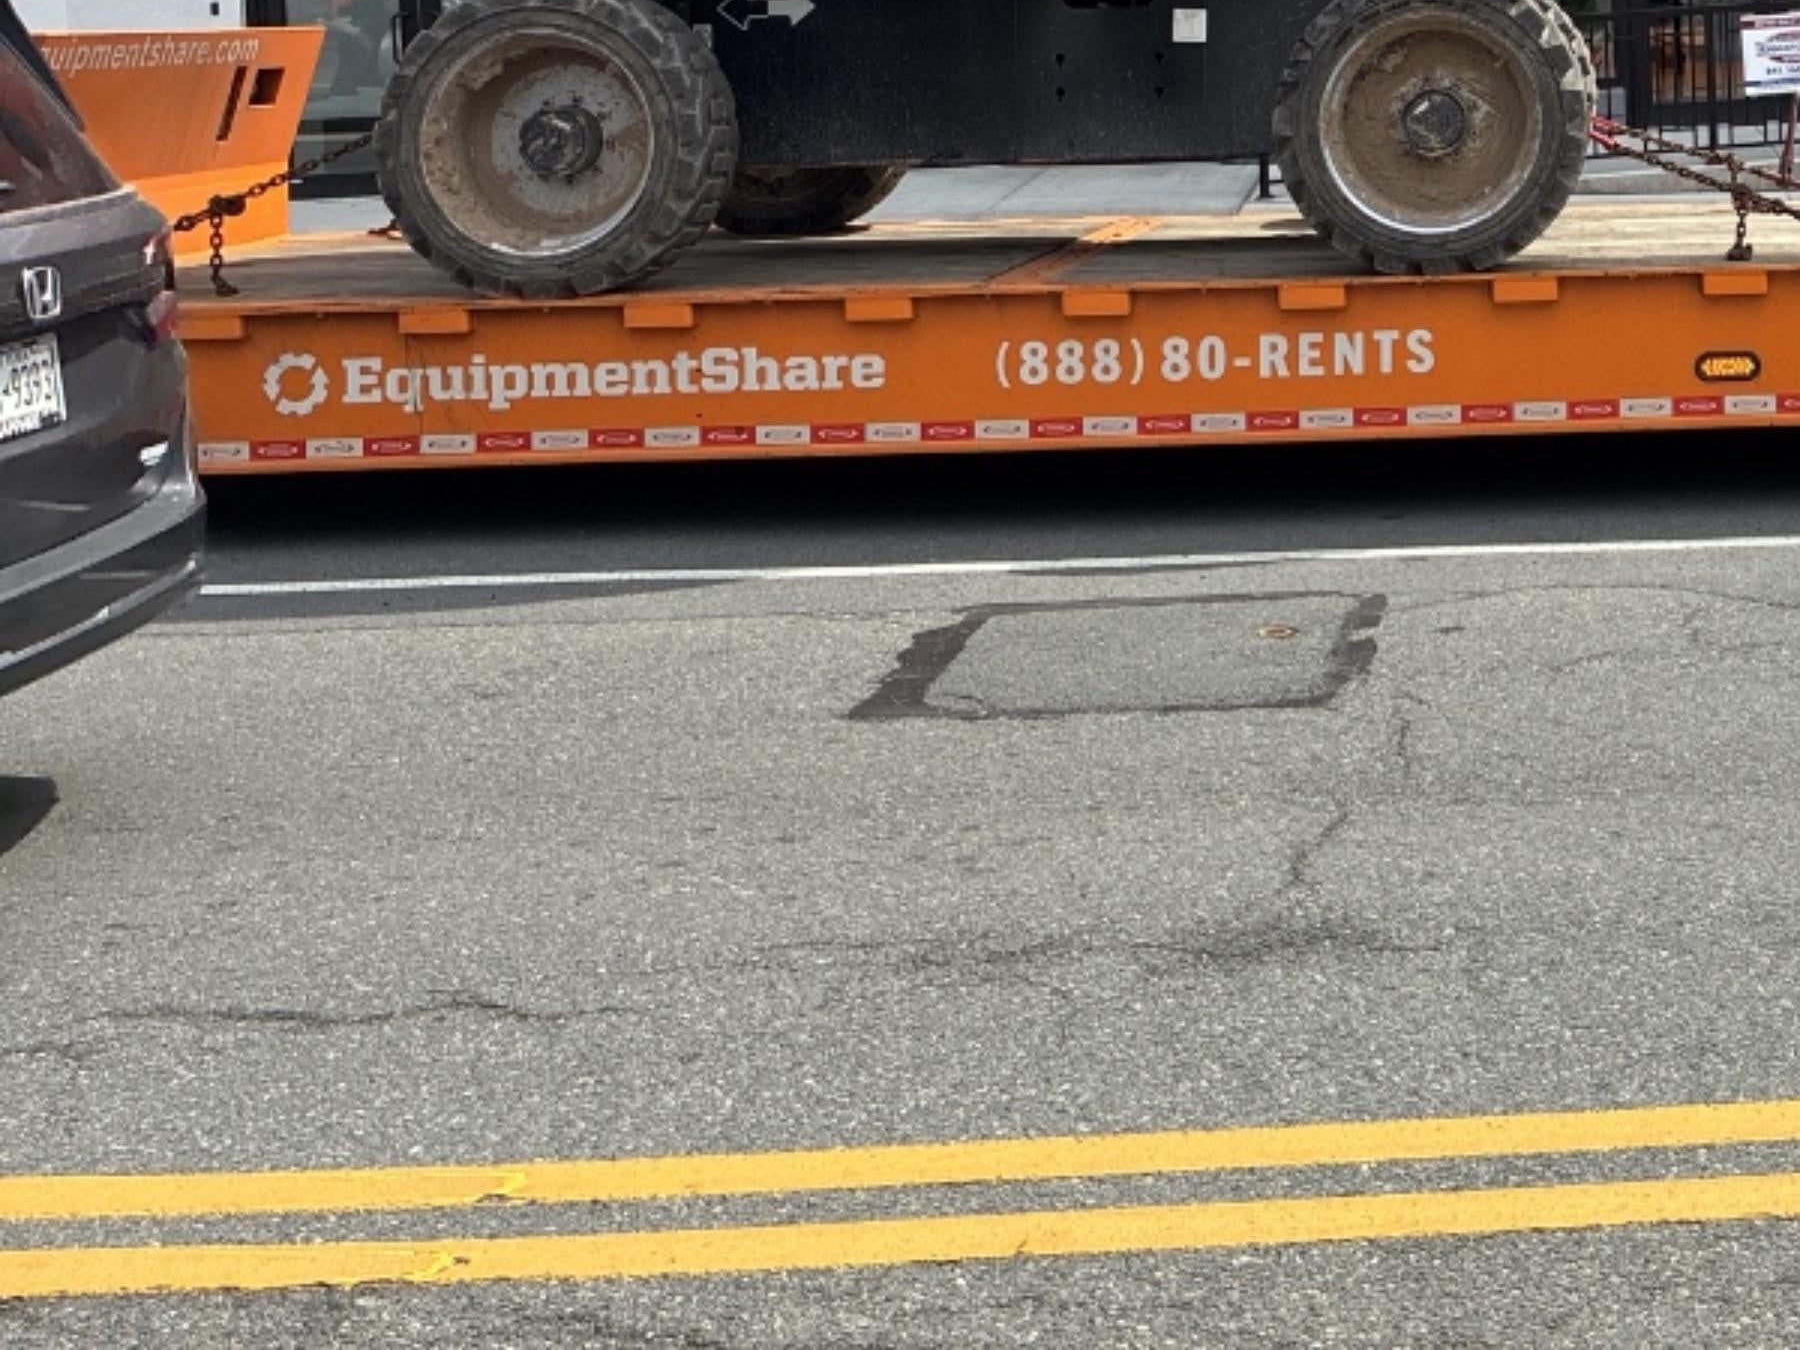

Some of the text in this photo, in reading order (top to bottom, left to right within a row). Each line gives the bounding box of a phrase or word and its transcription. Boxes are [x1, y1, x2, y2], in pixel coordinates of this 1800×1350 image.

[341, 347, 887, 413] EquipmentShare
[995, 328, 1436, 388] (888) 80-RENTS
